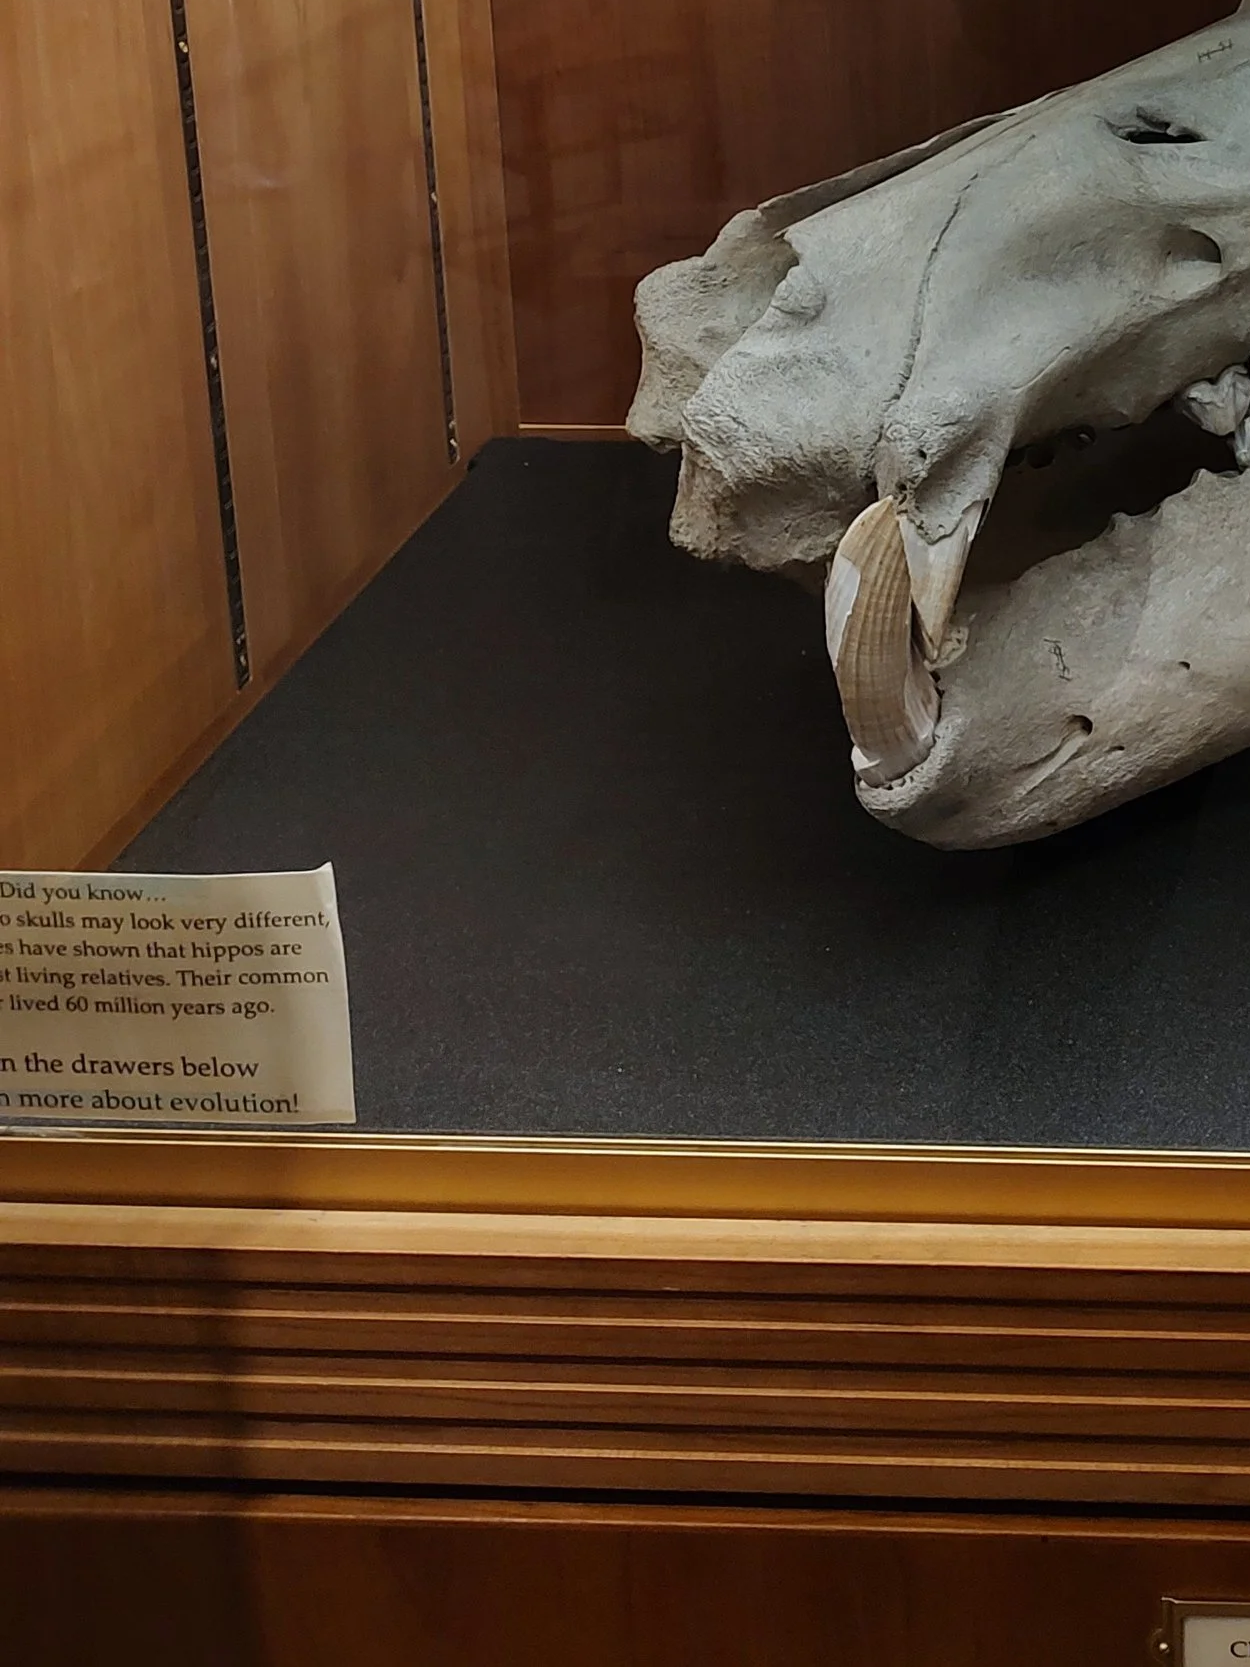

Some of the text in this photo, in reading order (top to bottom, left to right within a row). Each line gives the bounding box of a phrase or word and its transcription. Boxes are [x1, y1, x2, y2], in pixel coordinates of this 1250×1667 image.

[1, 882, 166, 905] Did you know...
[16, 910, 75, 928] skulls
[82, 916, 124, 934] may
[130, 913, 175, 930] look
[181, 917, 227, 934] very
[234, 911, 331, 928] different,
[19, 939, 67, 957] have
[73, 941, 140, 958] shown
[146, 942, 187, 958] that
[192, 942, 264, 962] hippos
[270, 943, 302, 955] are
[16, 967, 75, 989] living
[81, 969, 171, 986] relatives.
[177, 970, 232, 986] Their
[238, 971, 329, 985] common
[10, 994, 60, 1011] lived
[66, 996, 88, 1012] 60
[95, 997, 165, 1014] million
[171, 1001, 225, 1020] years
[231, 1000, 275, 1019] ago.
[25, 1052, 63, 1073] the
[71, 1053, 174, 1076] drawers
[180, 1056, 259, 1077] below
[18, 1093, 84, 1108] more
[91, 1089, 163, 1110] about
[170, 1092, 299, 1113] evolution!
